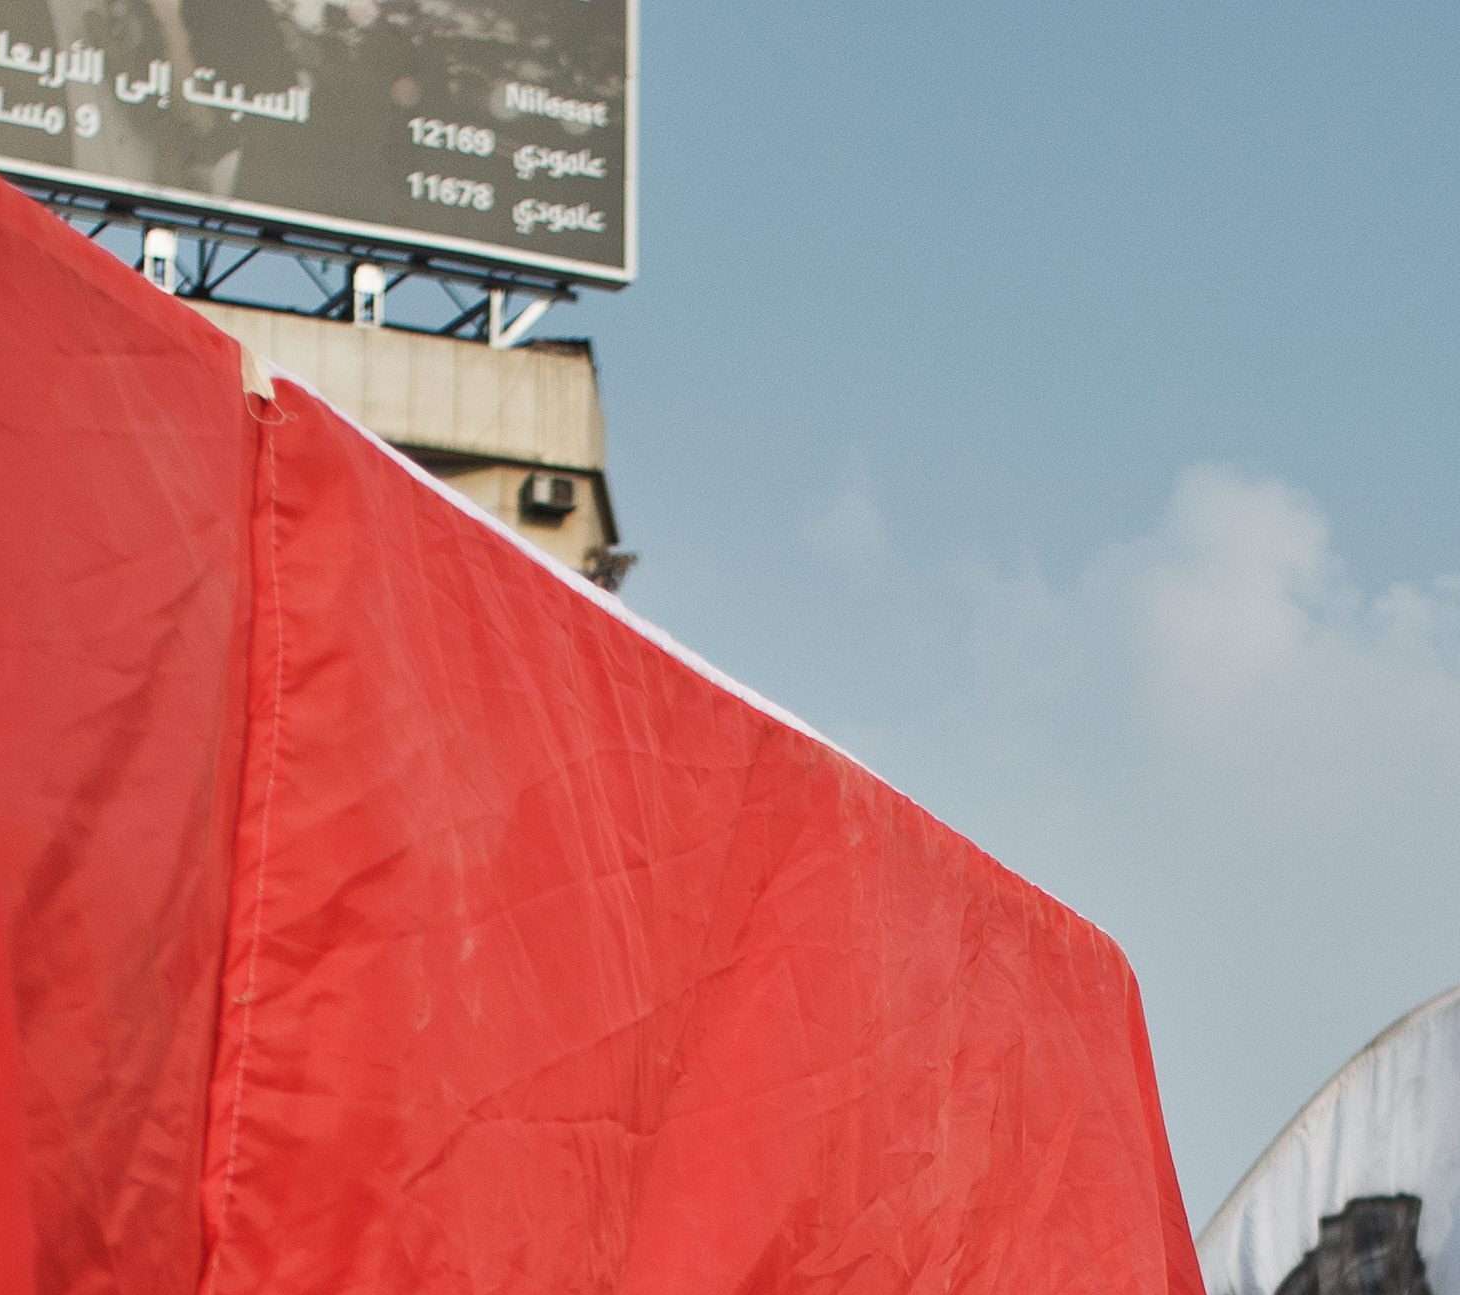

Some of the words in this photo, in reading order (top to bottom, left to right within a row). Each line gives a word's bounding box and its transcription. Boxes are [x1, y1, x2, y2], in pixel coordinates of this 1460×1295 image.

[114, 58, 174, 109] إلى
[182, 68, 311, 123] السبت
[505, 82, 609, 128] Nilesat
[74, 103, 102, 139] 9
[407, 115, 496, 157] 12169
